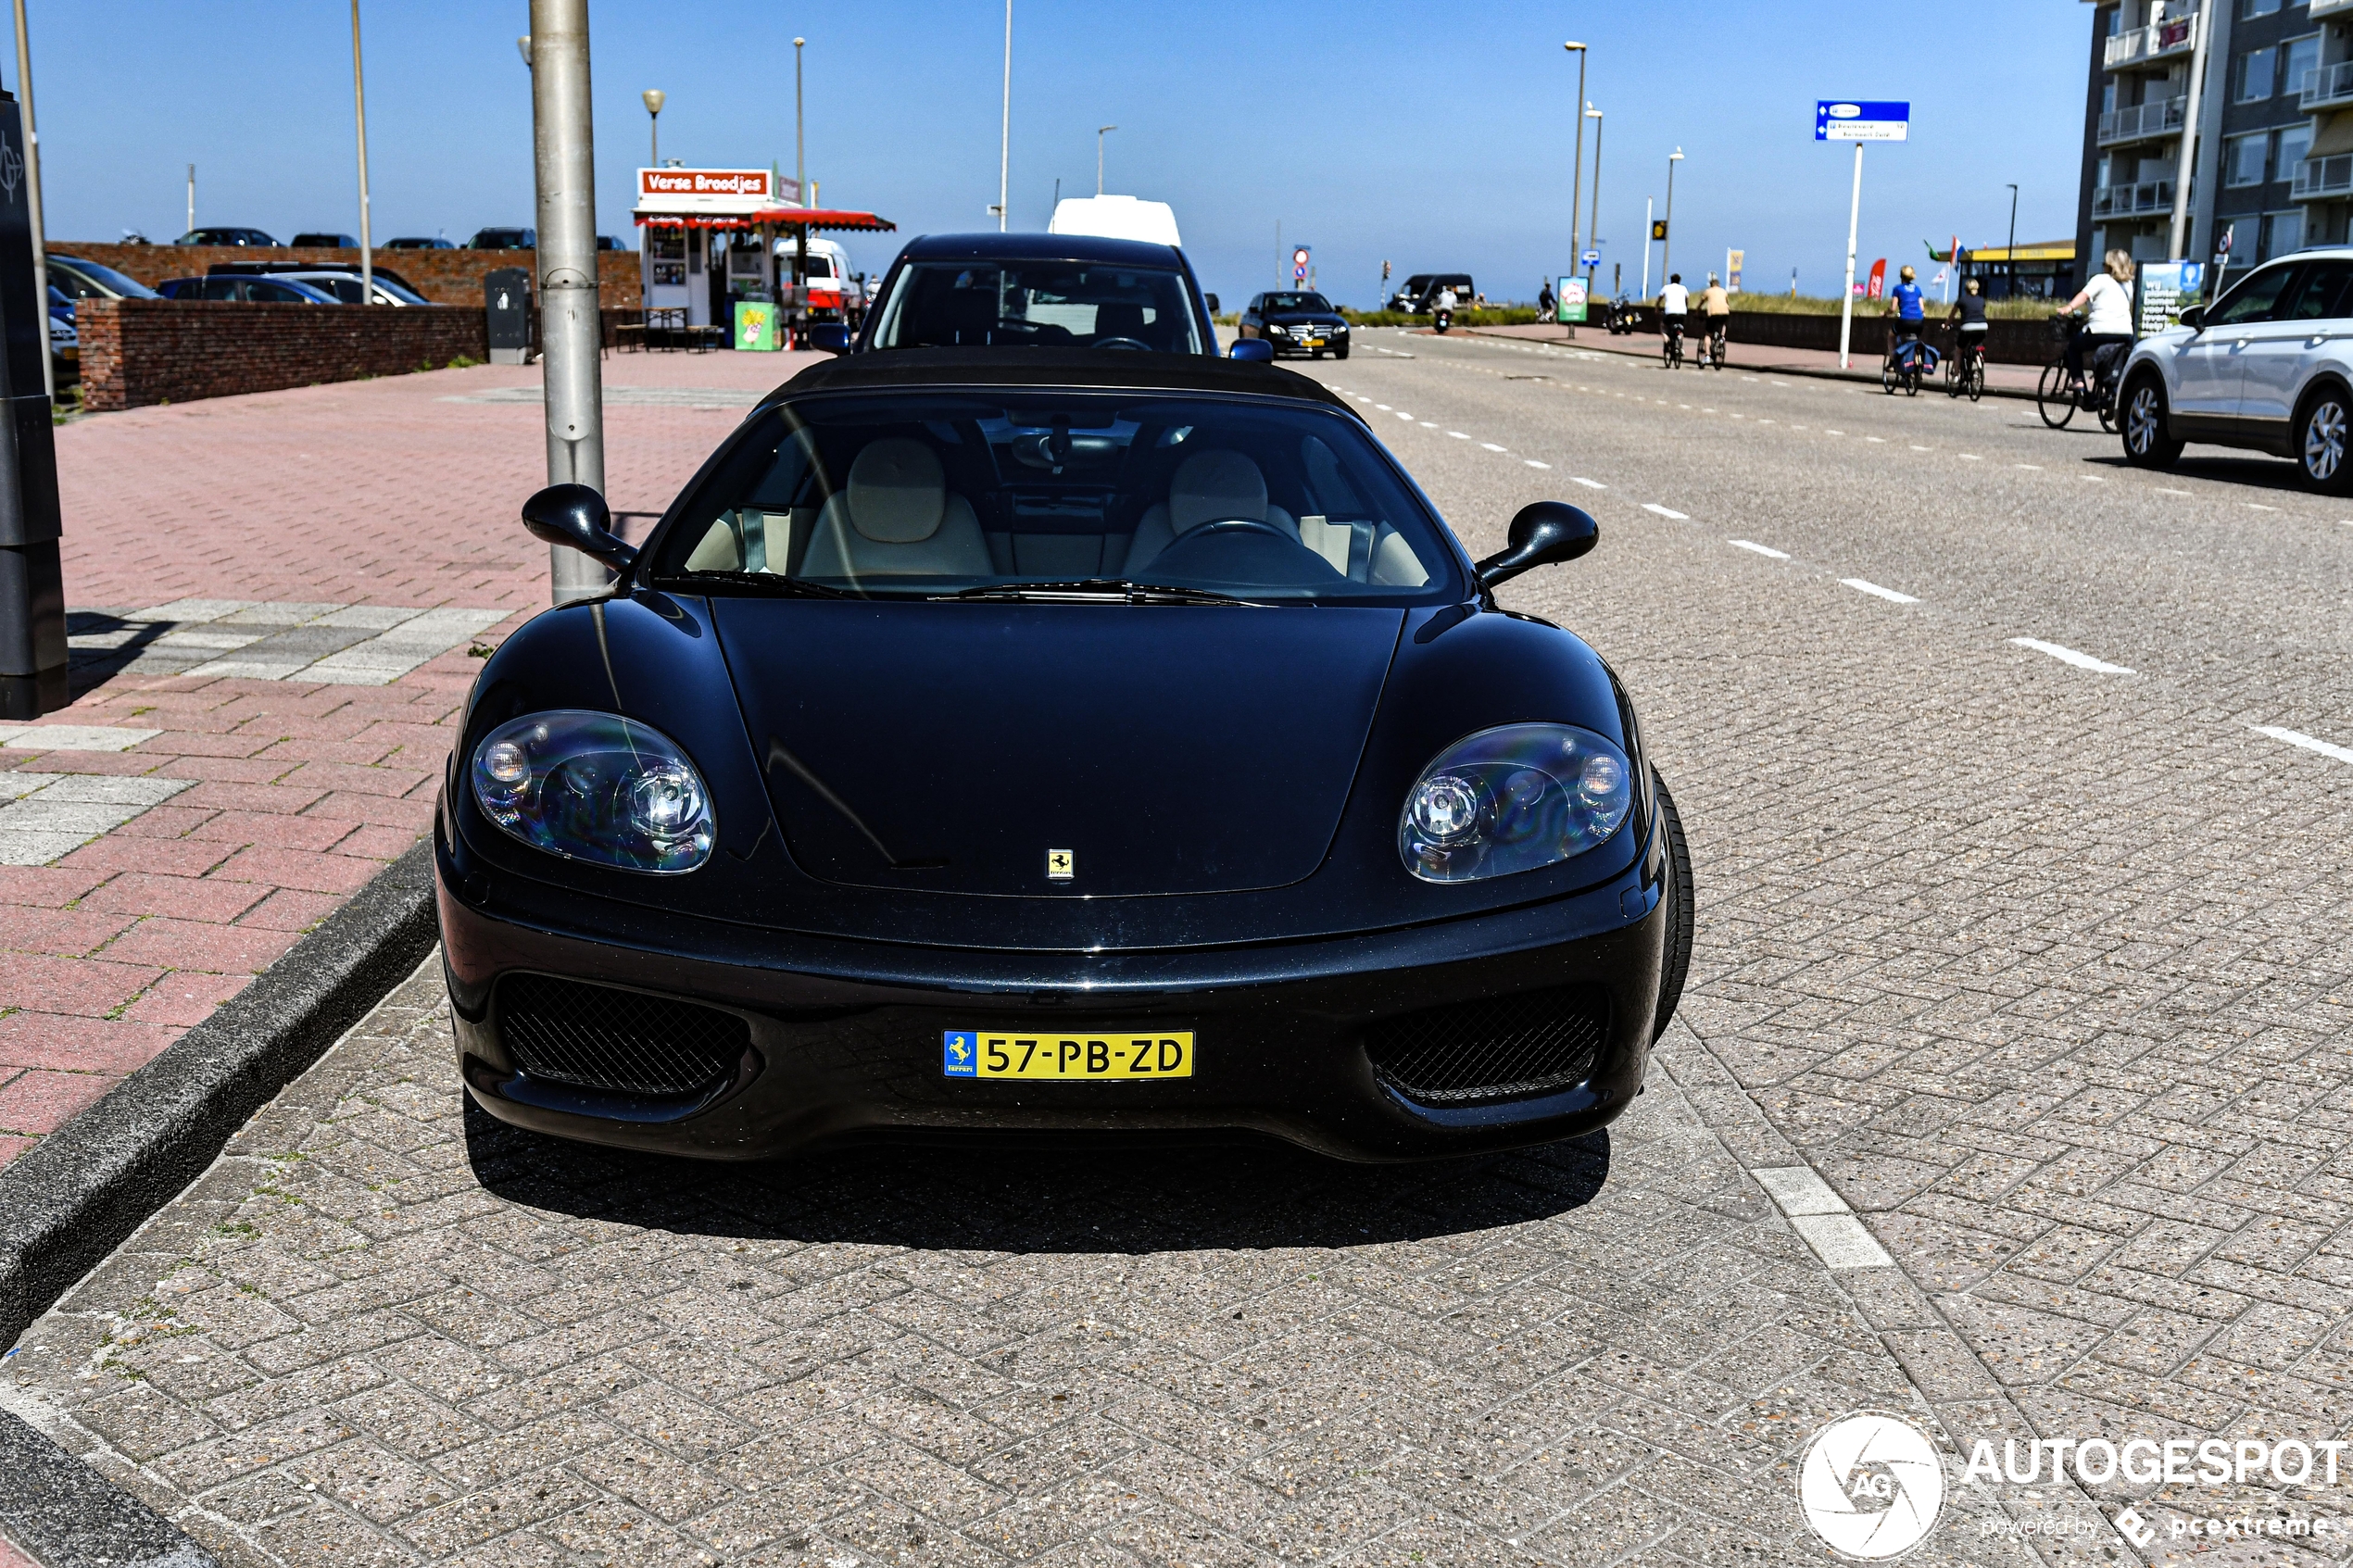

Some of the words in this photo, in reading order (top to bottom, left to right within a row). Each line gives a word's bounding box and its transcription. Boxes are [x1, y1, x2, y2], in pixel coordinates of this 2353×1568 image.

[648, 174, 693, 191] Verse
[695, 174, 761, 194] Broodjes
[2145, 290, 2181, 299] planten
[2144, 296, 2176, 306] bomen
[2143, 306, 2165, 314] voor
[2165, 305, 2181, 314] het
[2141, 320, 2164, 332] Help
[987, 1038, 1184, 1073] 57-PB-ZD
